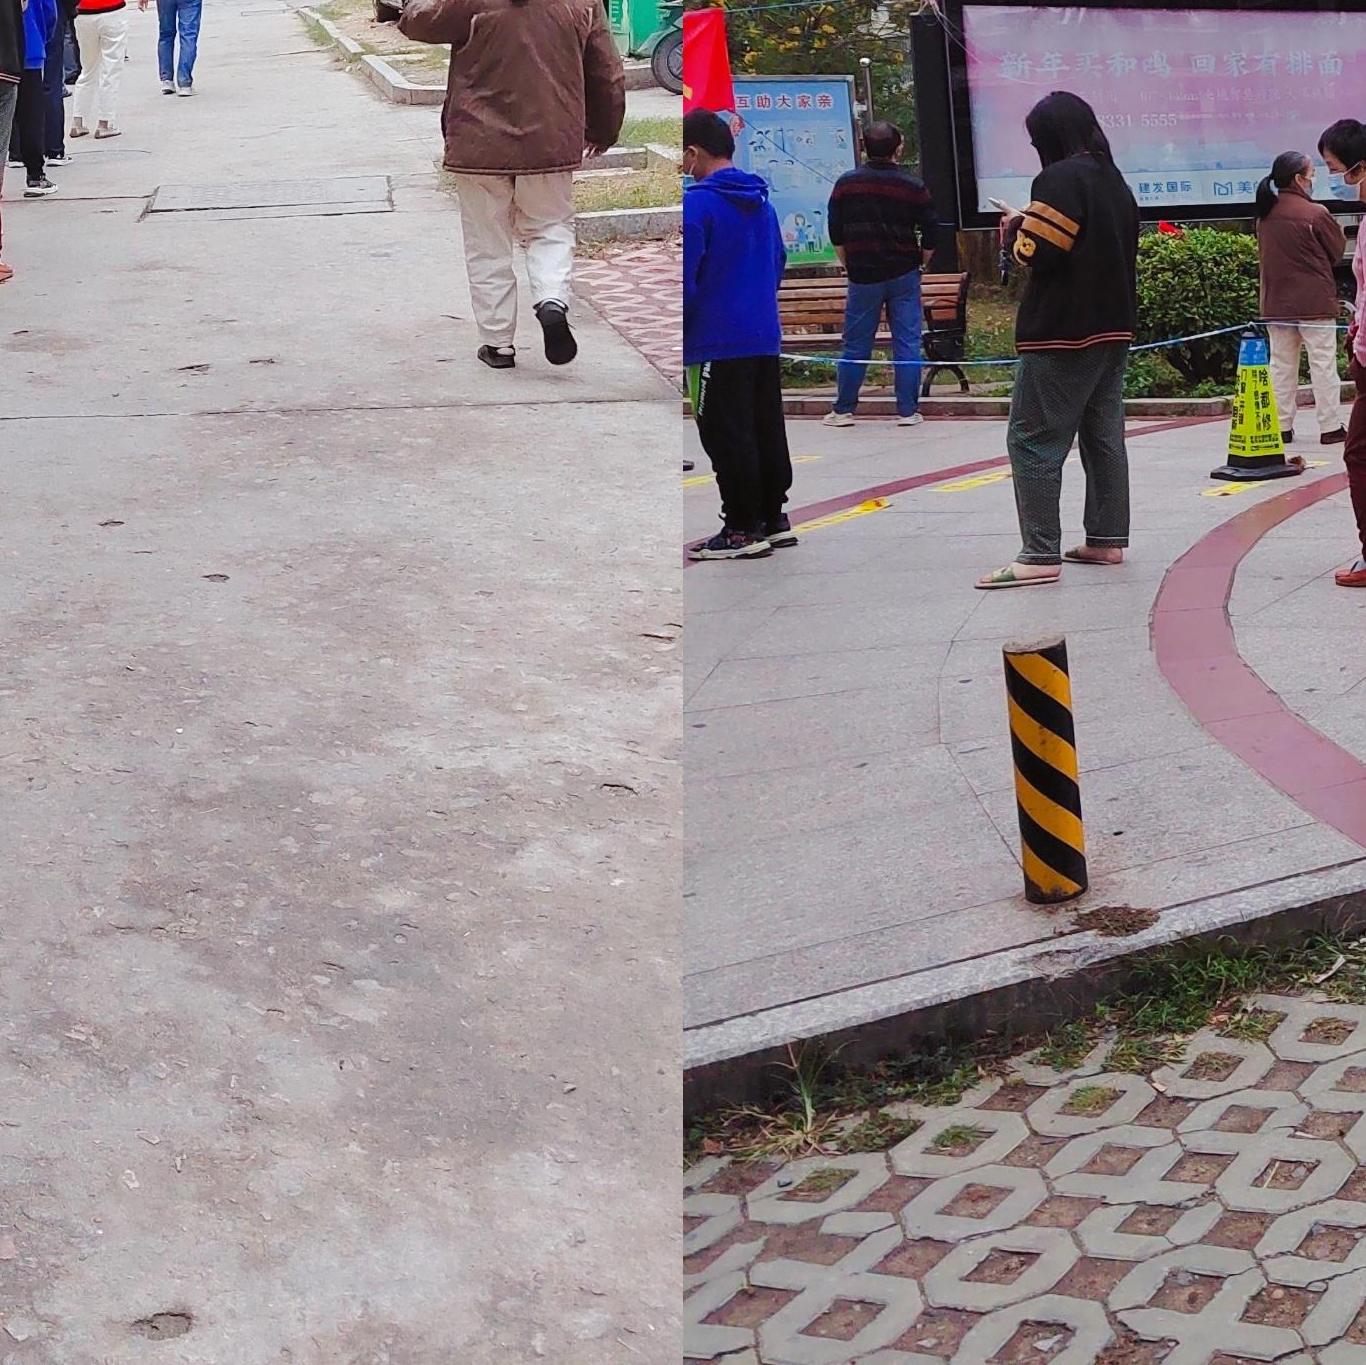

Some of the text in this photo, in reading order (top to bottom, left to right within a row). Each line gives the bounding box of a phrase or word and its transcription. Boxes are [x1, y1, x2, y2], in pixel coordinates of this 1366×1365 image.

[736, 93, 834, 110] 互助大家亲
[1141, 114, 1177, 128] 5555
[1138, 179, 1193, 194] 建发国际
[1237, 180, 1258, 195] 美
